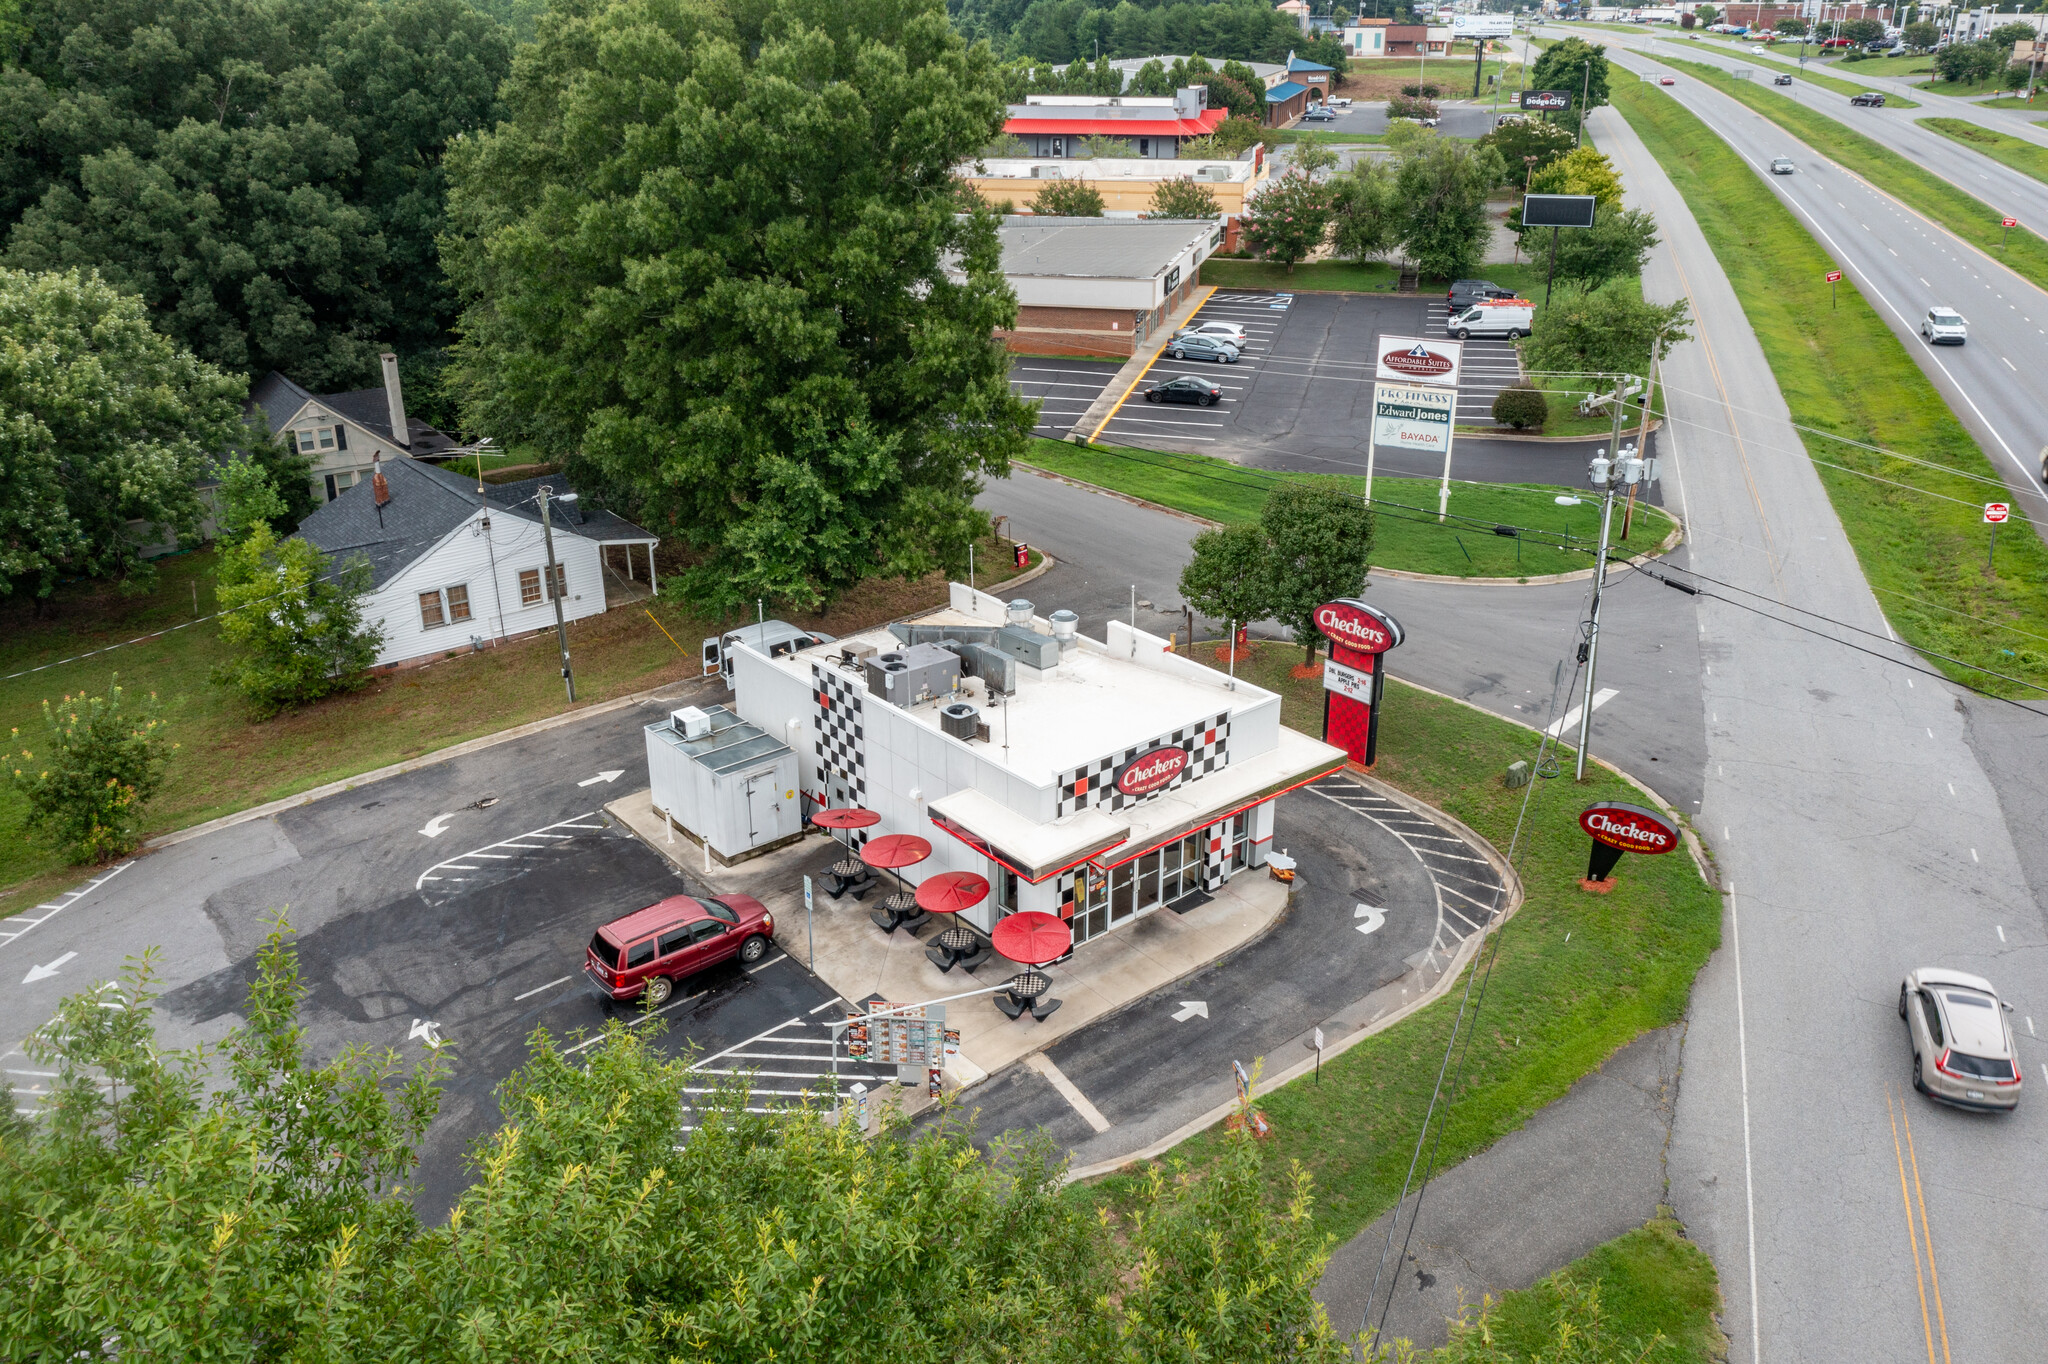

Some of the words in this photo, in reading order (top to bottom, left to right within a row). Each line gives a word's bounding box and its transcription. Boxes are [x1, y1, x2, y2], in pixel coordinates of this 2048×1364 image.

[1526, 98, 1549, 106] Dodge
[1550, 98, 1566, 106] City
[1428, 359, 1450, 368] SUITES
[1379, 404, 1415, 418] Edward
[1416, 409, 1448, 421] Jones
[1401, 432, 1438, 443] BAYADA
[1319, 609, 1385, 644] Checkers
[1330, 632, 1344, 643] CRAZY
[1344, 639, 1358, 648] GOOD
[1337, 677, 1350, 686] APPLE
[1350, 681, 1360, 690] PIES
[1123, 755, 1183, 787] Checkers
[1134, 784, 1147, 792] CRAZY
[1148, 780, 1160, 789] GOOD
[1160, 774, 1171, 784] FOOD
[1587, 814, 1667, 845] Checkers
[1600, 834, 1618, 844] CRAZY
[1618, 841, 1634, 849] GOOD
